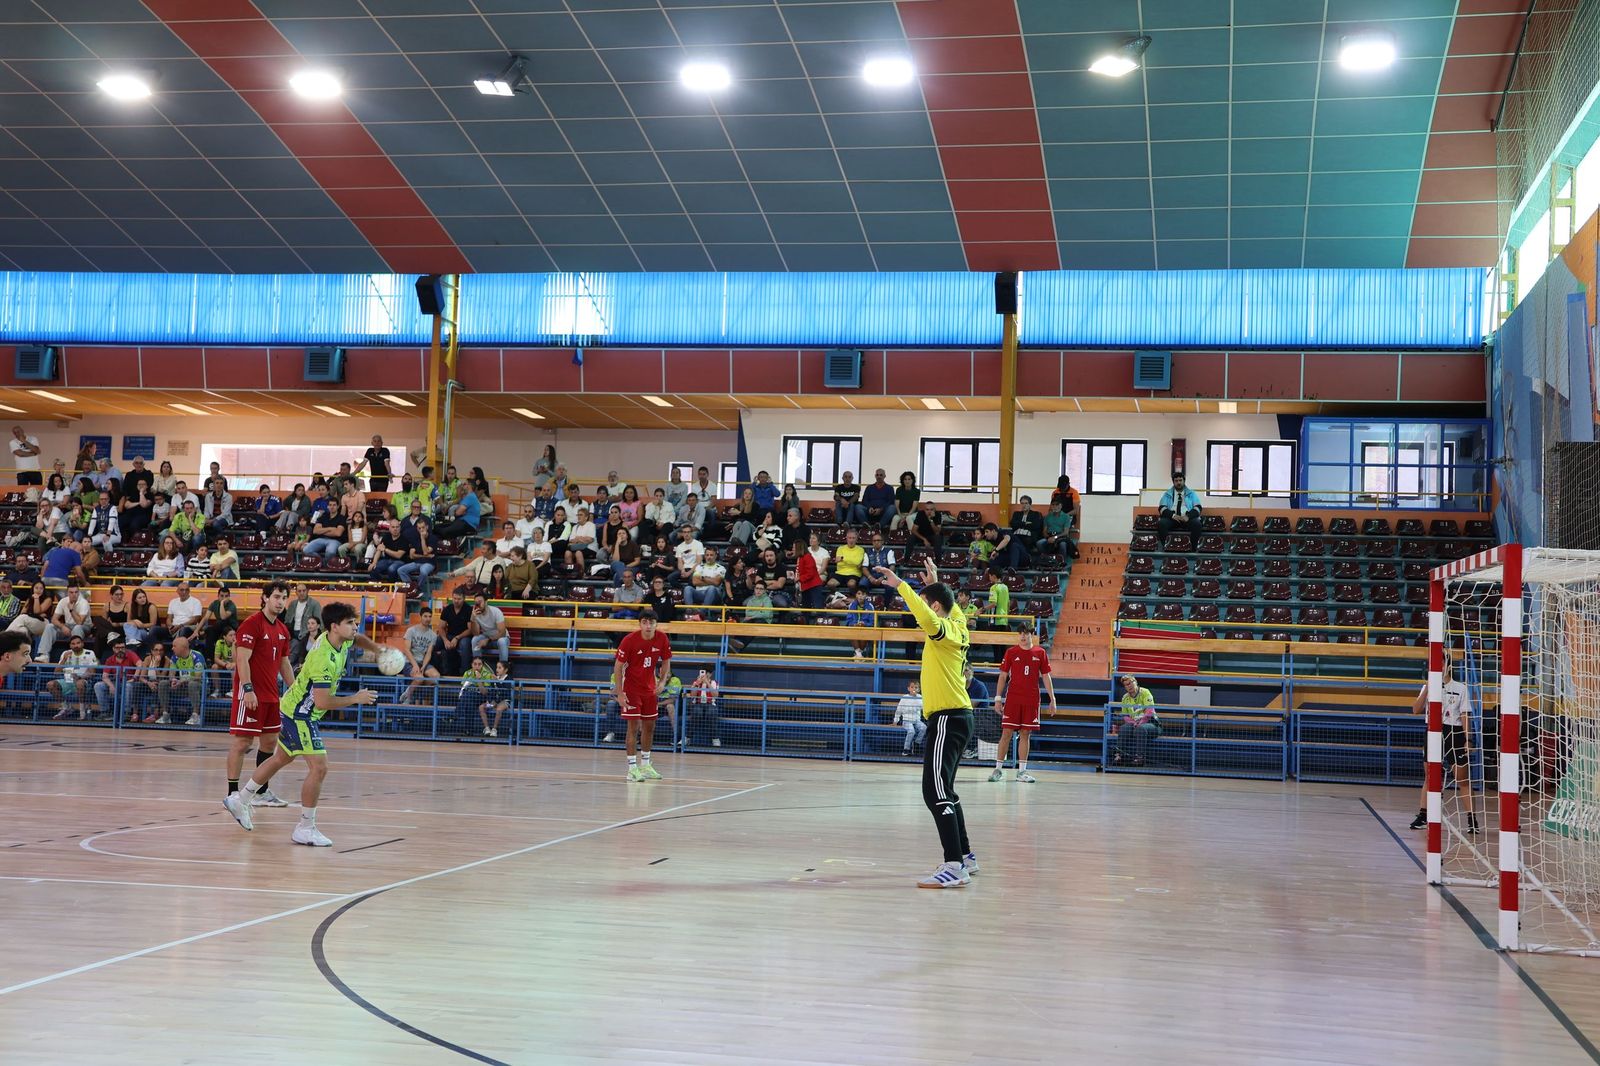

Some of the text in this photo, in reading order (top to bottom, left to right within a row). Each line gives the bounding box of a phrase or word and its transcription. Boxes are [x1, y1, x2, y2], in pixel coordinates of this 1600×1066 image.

[1081, 579, 1103, 587] FILA
[1075, 602, 1097, 610] FILA
[1068, 626, 1092, 634] FILA
[1062, 652, 1086, 661] FILA
[1024, 665, 1029, 675] 8
